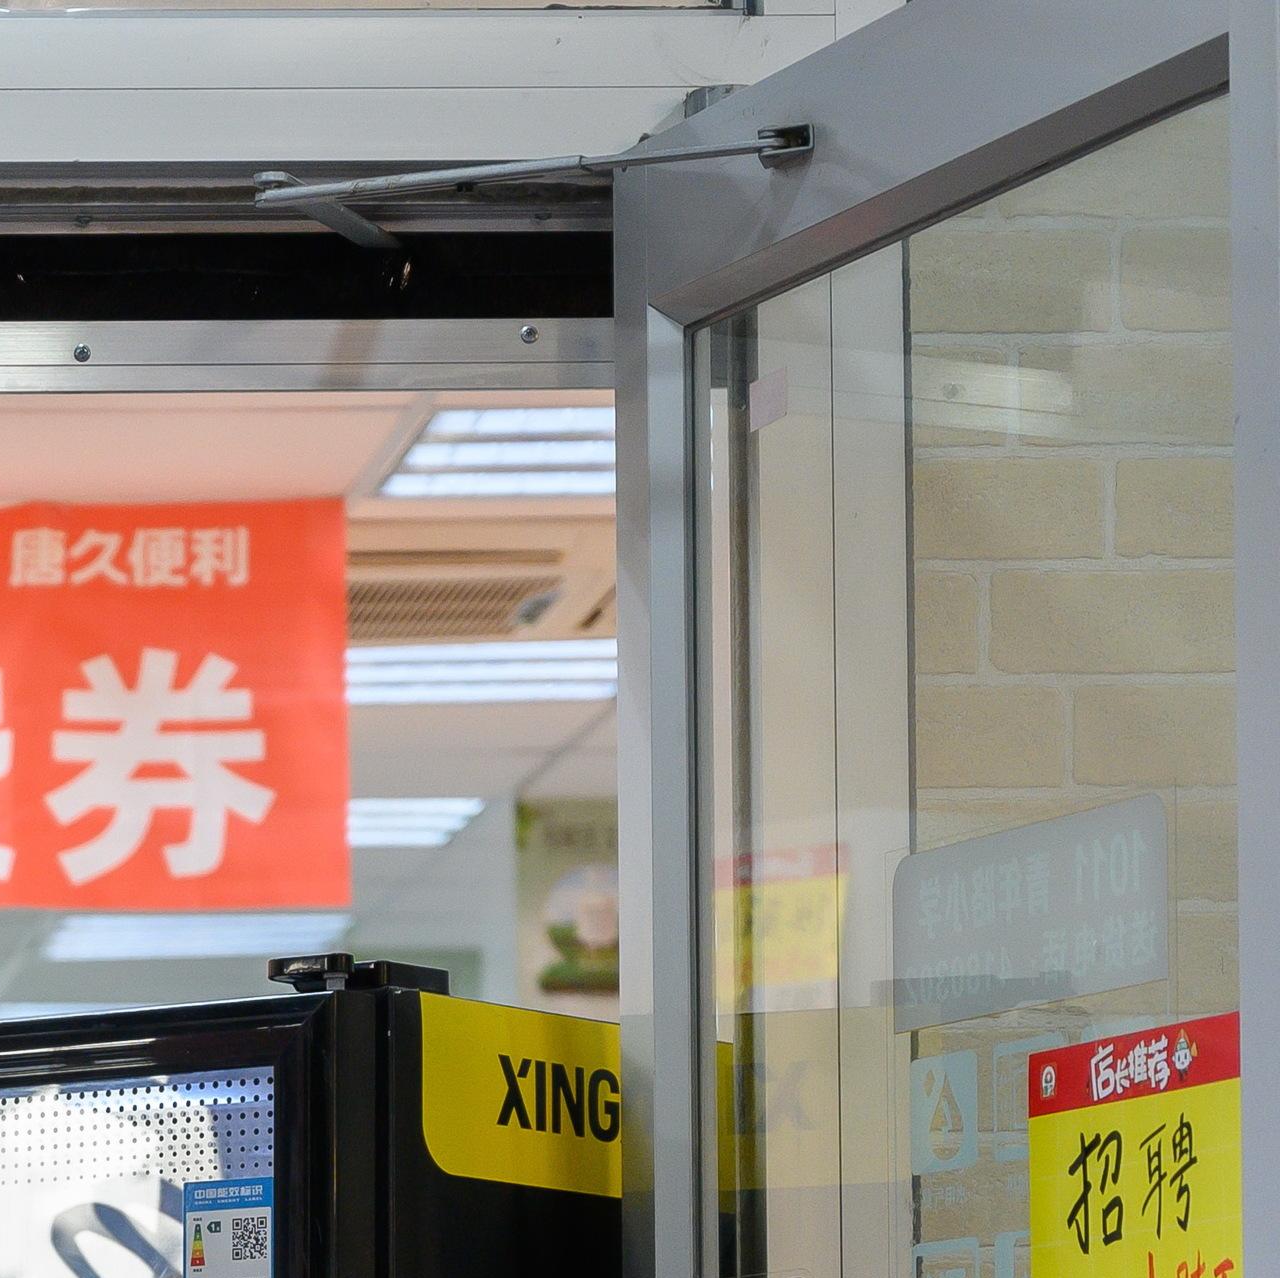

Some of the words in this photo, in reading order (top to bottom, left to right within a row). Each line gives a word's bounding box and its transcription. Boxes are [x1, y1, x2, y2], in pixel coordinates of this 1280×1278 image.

[7, 526, 252, 593] 唐久便利
[496, 1053, 621, 1144] XING
[1090, 1034, 1171, 1101] 店长推荐
[1067, 1111, 1198, 1255] 招聘
